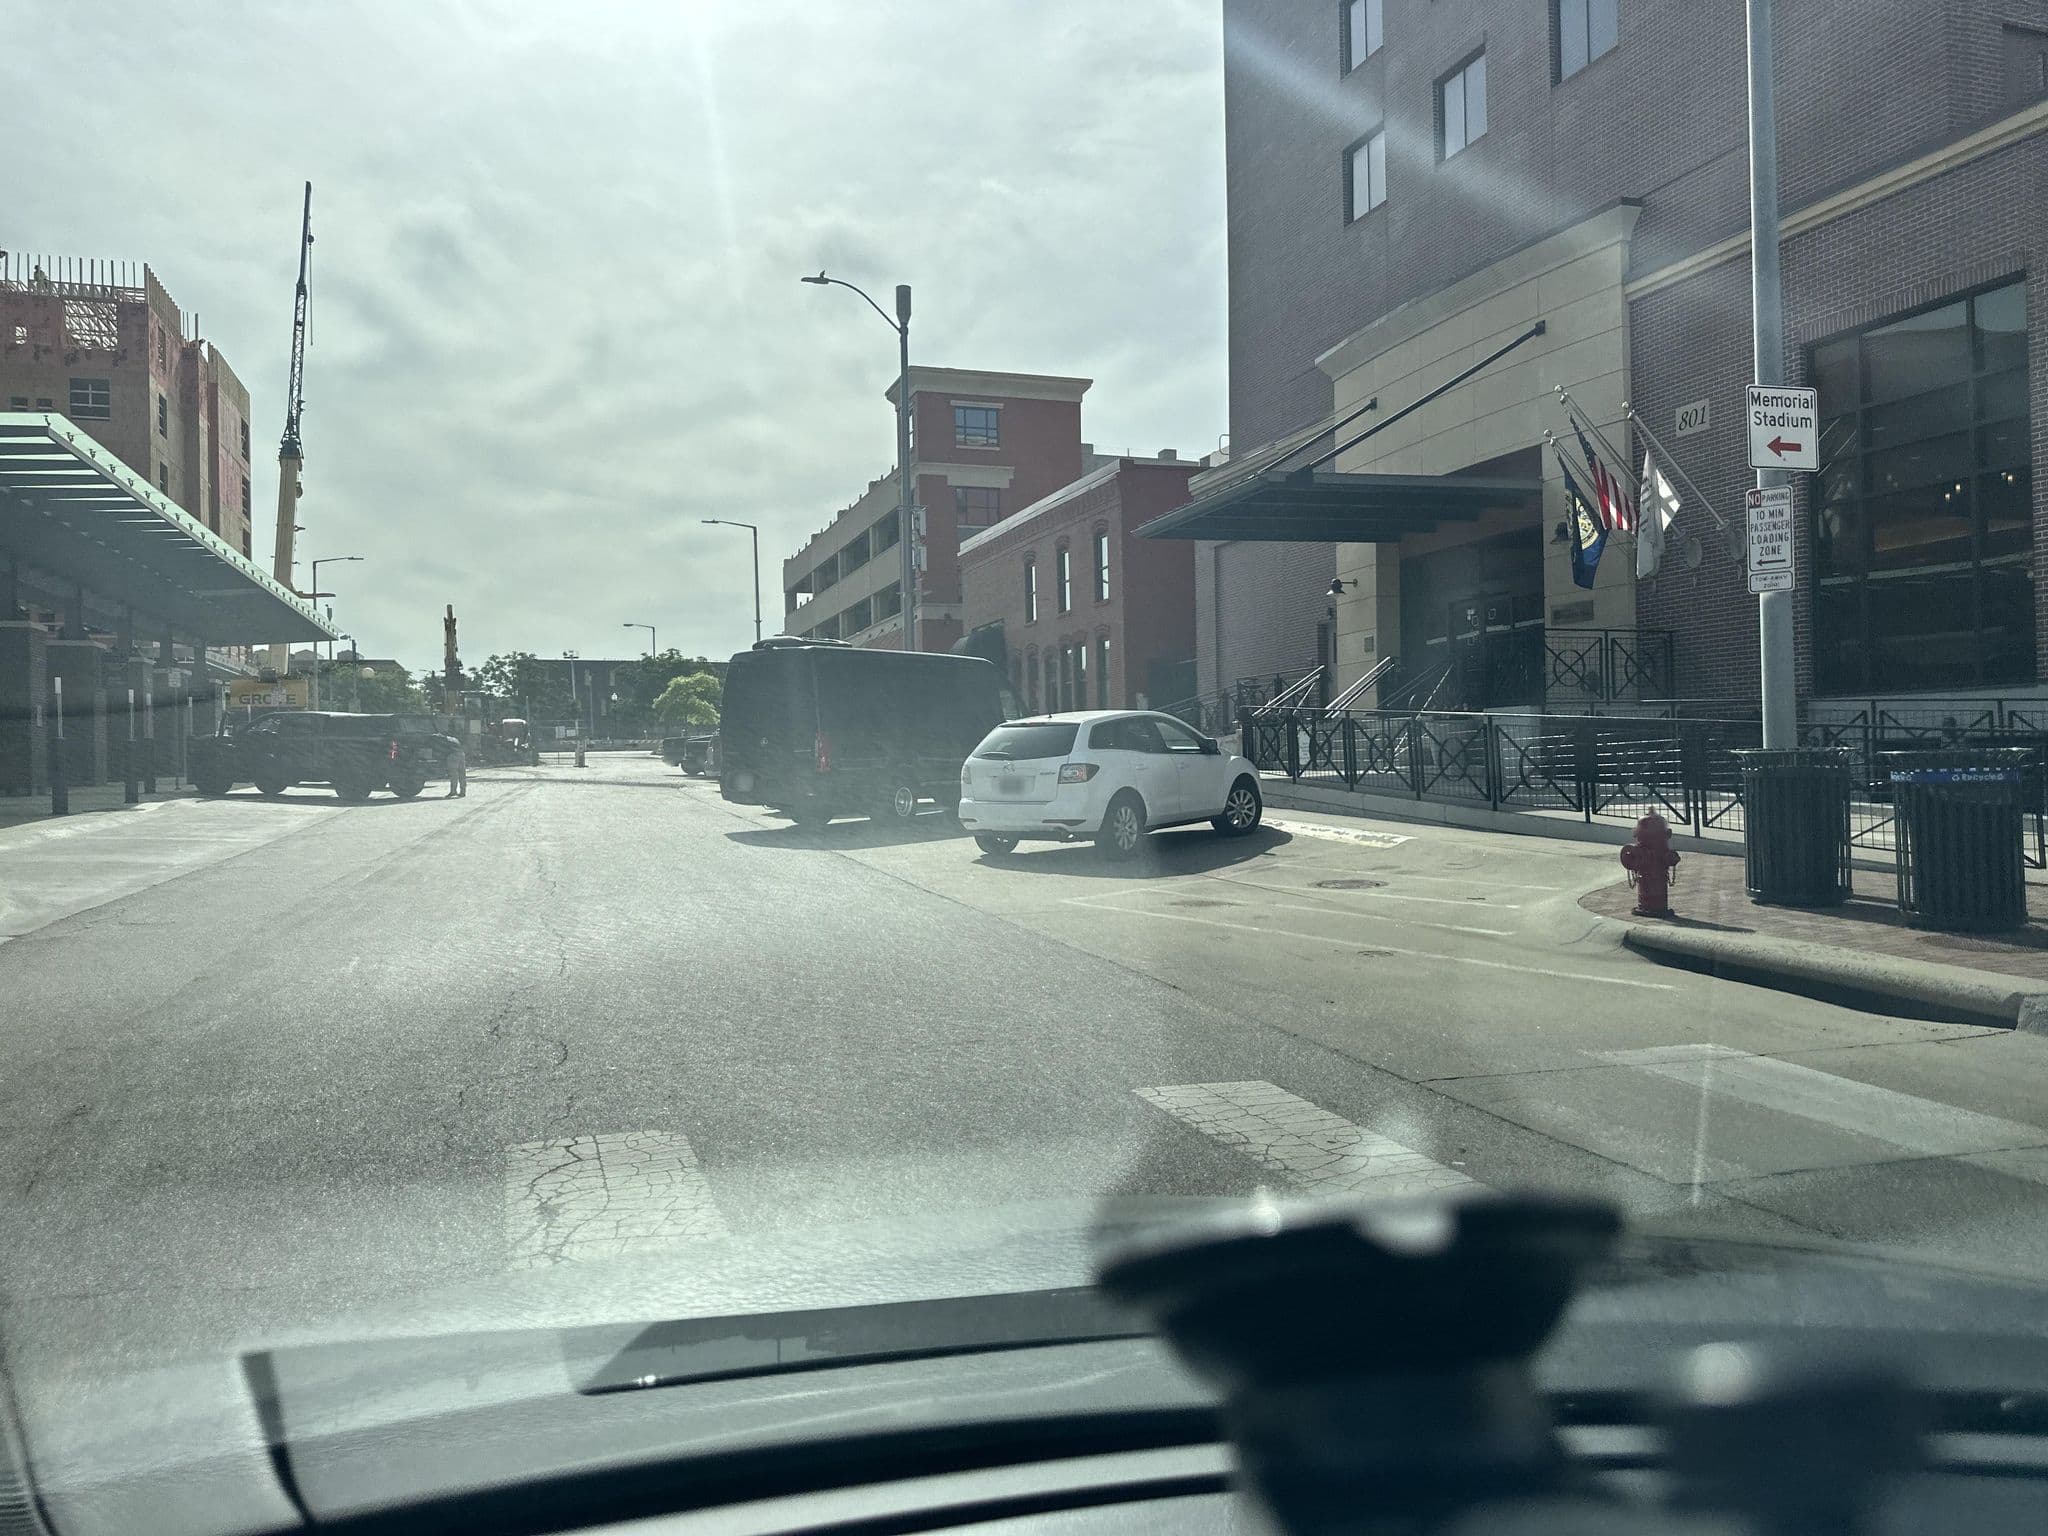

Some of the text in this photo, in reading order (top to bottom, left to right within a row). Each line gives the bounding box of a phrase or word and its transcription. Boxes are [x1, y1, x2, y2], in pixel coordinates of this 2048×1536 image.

[1750, 391, 1813, 409] Memorial
[1678, 405, 1706, 431] 801
[1753, 410, 1812, 429] Stadium
[1748, 491, 1790, 506] NO PARKING
[1756, 508, 1784, 521] 10 MIN
[1750, 519, 1790, 533] PASSENGER
[1751, 531, 1790, 545] LOADING
[1760, 544, 1782, 557] ZONE
[238, 693, 297, 705] GROE
